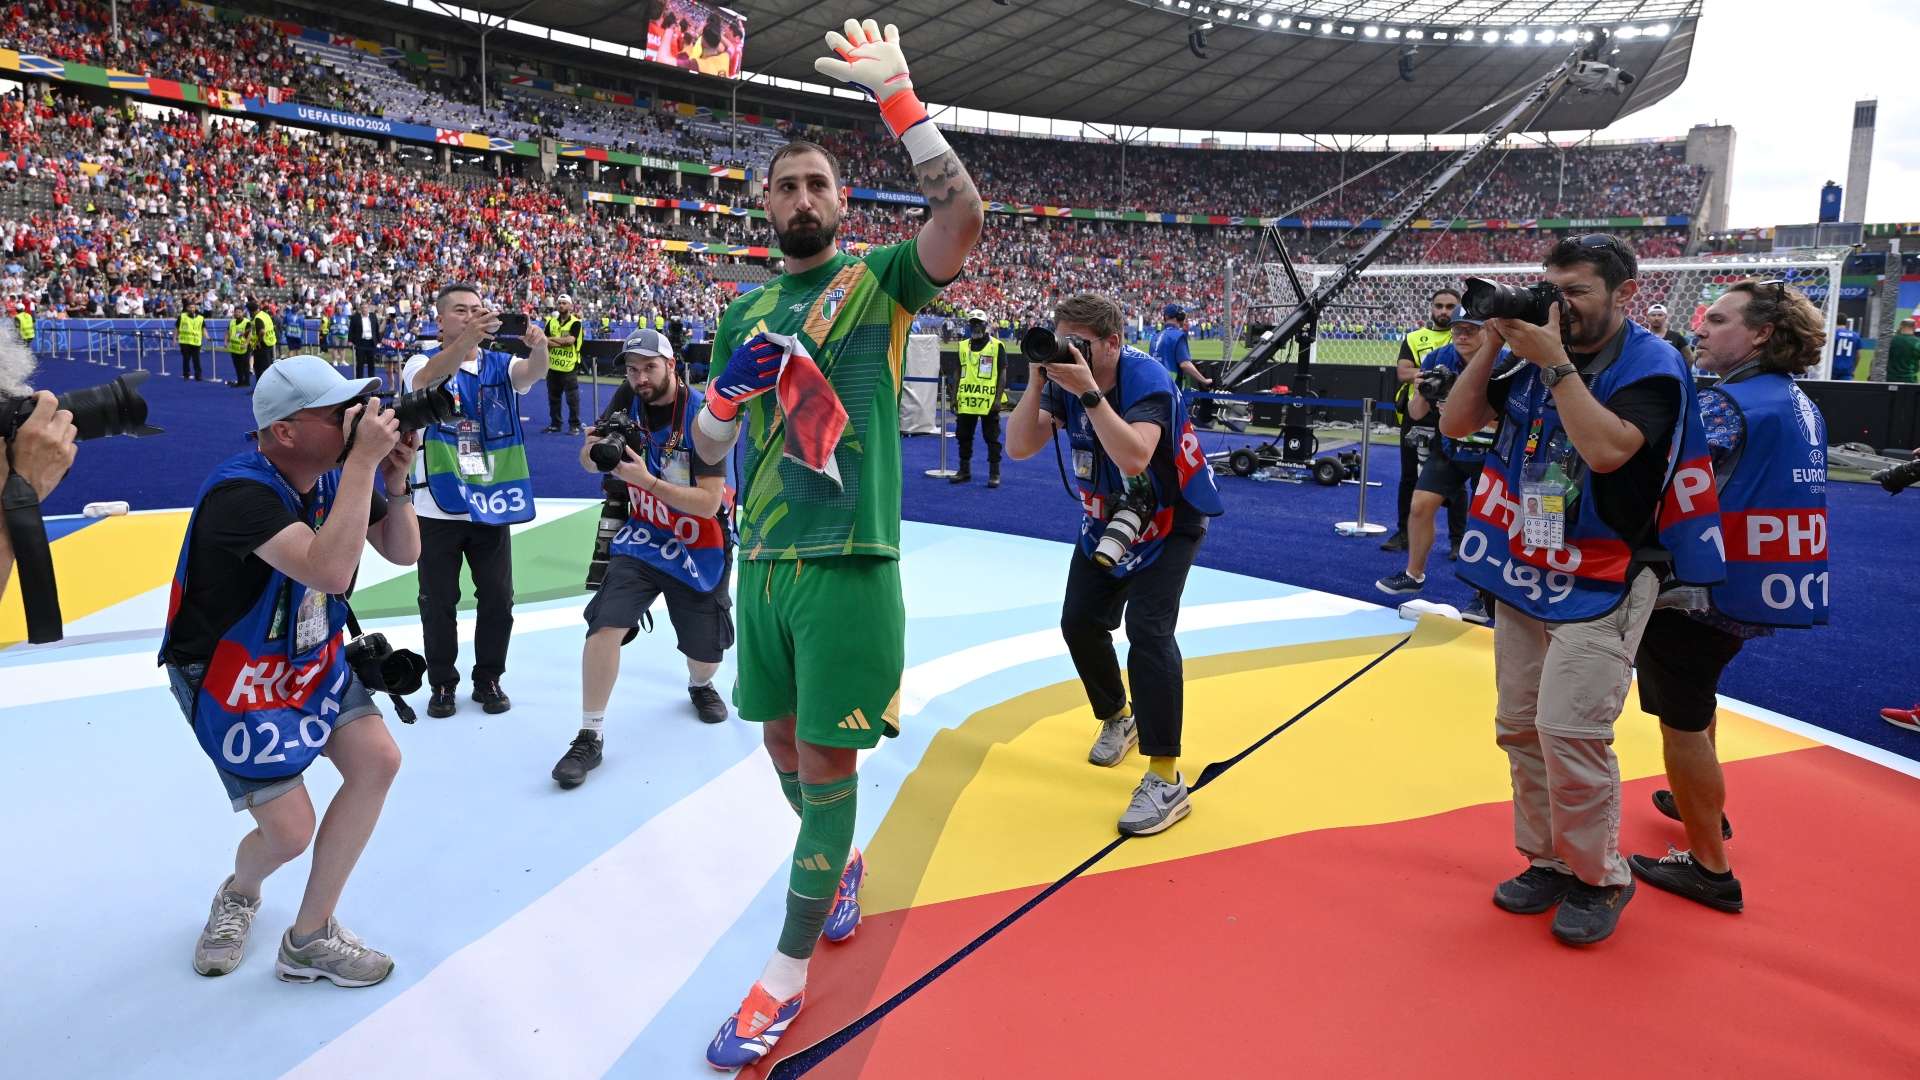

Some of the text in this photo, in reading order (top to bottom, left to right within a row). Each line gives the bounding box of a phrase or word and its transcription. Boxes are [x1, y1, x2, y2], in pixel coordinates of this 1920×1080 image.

[1836, 338, 1853, 357] 14
[959, 397, 990, 409] -1371
[628, 486, 700, 545] PHOO
